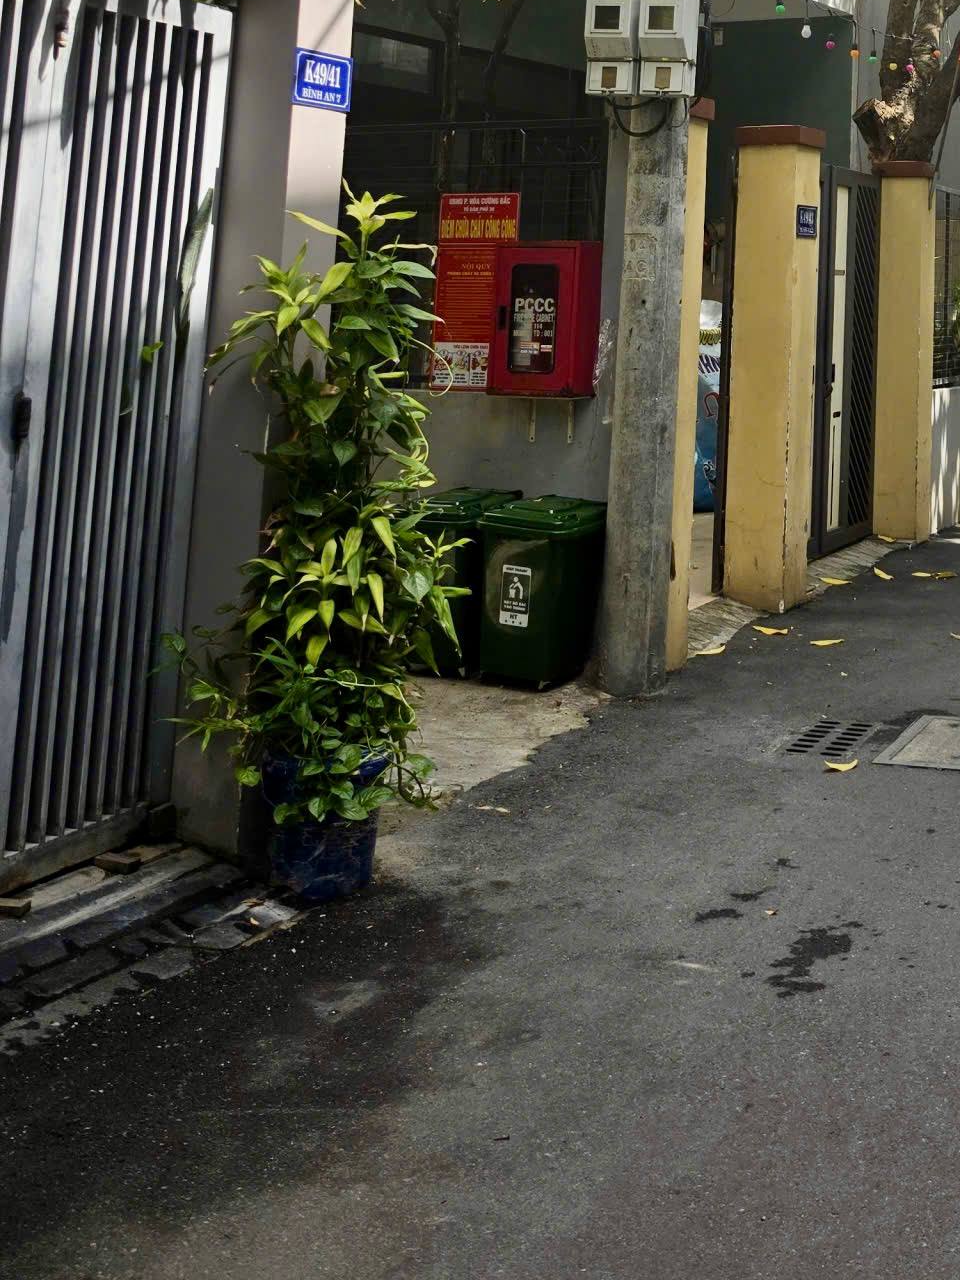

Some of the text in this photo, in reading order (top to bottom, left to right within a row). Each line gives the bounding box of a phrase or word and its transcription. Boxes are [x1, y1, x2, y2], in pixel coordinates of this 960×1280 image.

[304, 59, 341, 88] K49/41
[302, 86, 341, 103] BÌNH AN 7
[514, 298, 554, 312] PCCC
